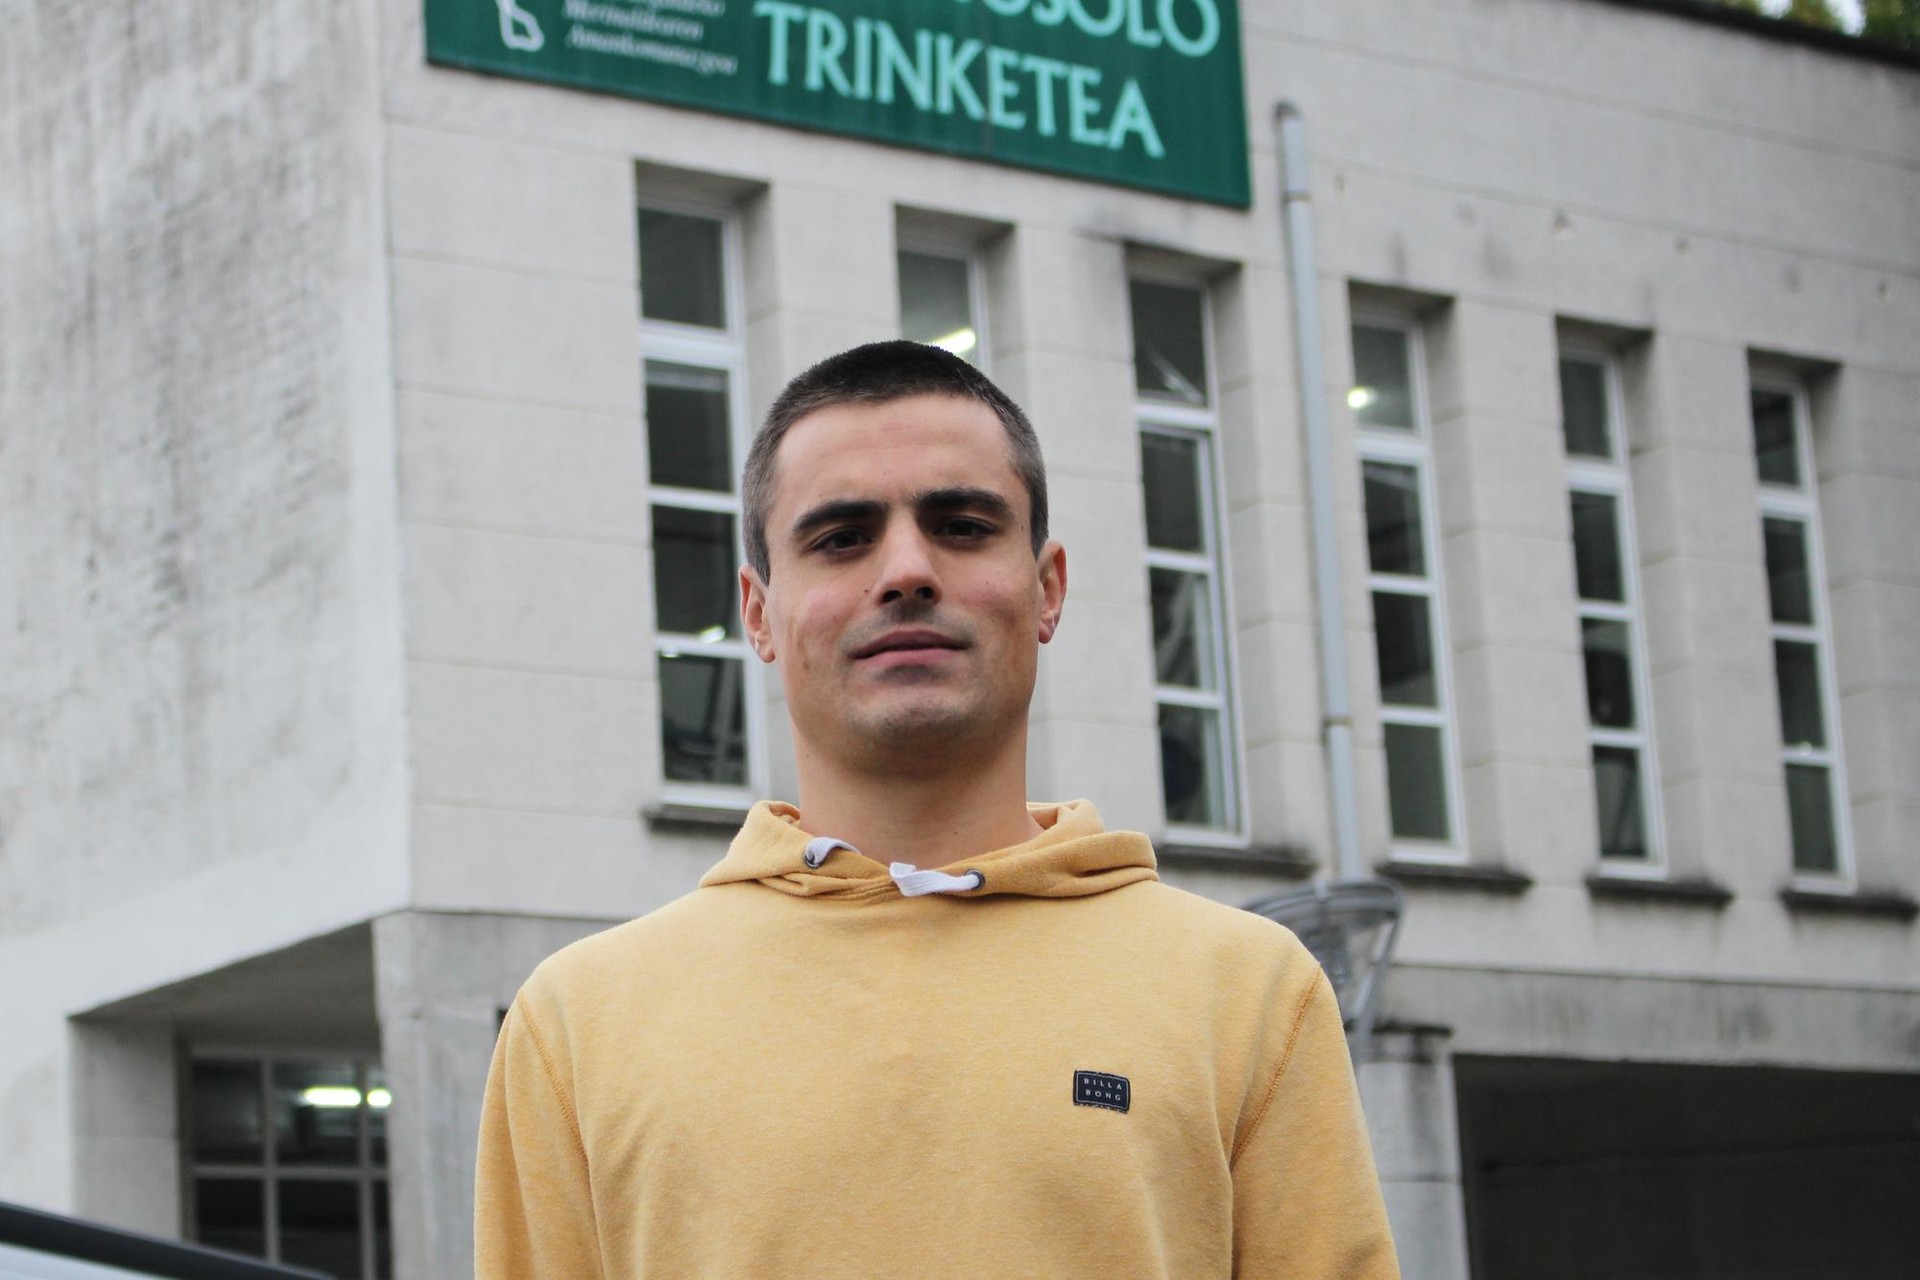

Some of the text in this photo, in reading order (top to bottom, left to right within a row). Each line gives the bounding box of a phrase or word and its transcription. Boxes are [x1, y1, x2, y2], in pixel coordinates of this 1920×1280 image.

[753, 1, 1165, 158] TRINKETEA
[1084, 1077, 1122, 1090] BILLA
[1085, 1089, 1121, 1101] BONG
